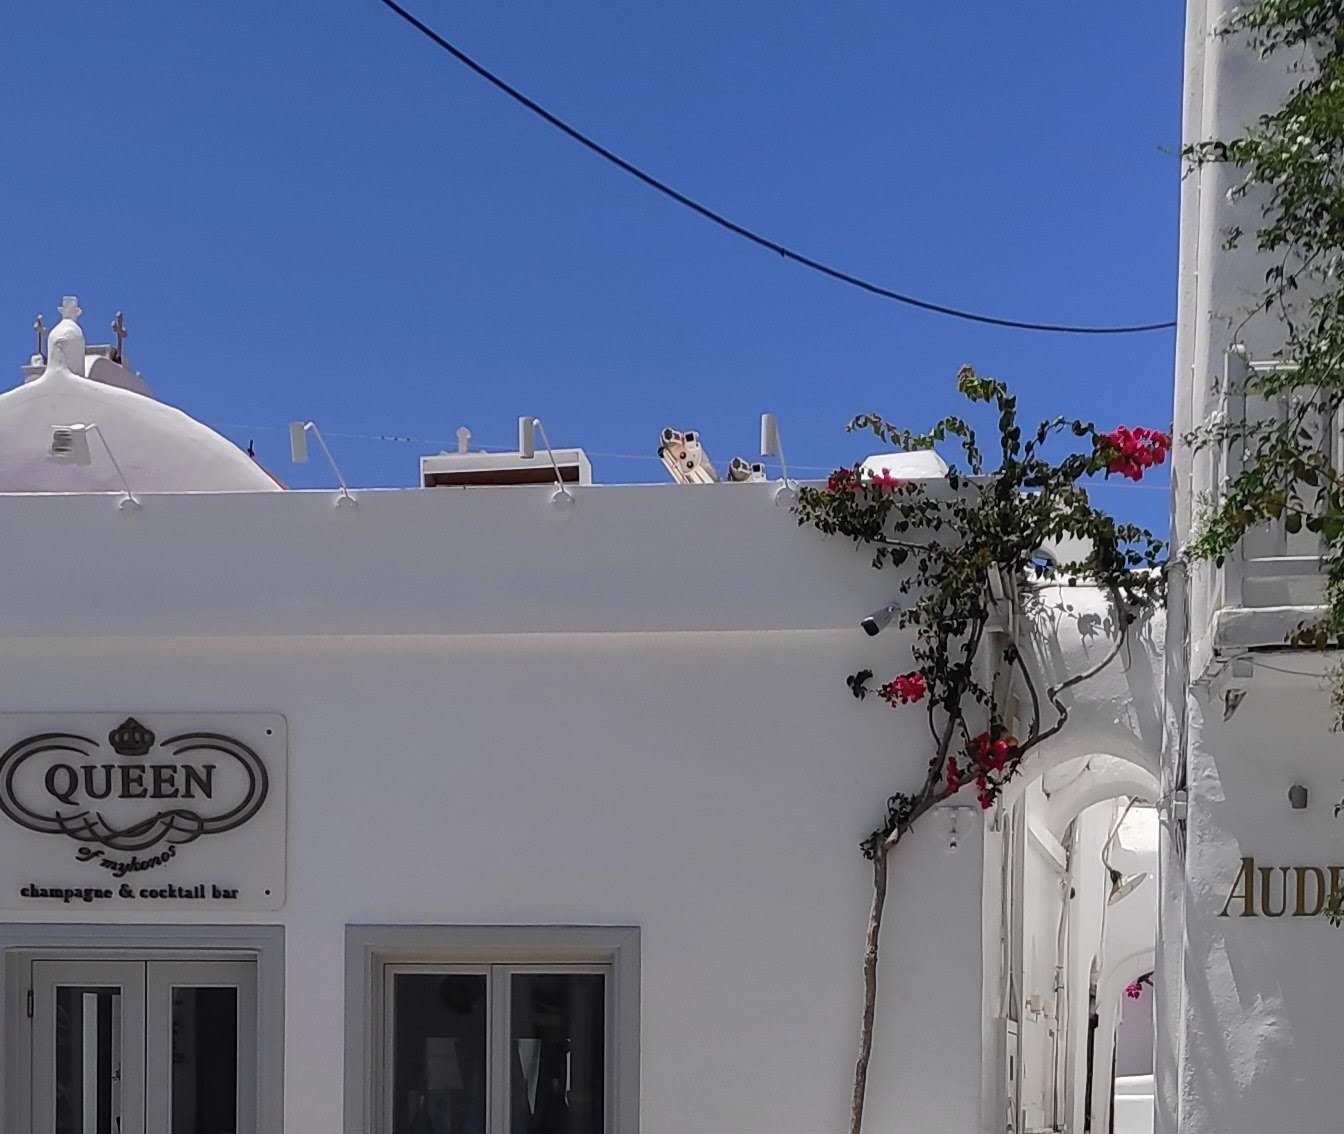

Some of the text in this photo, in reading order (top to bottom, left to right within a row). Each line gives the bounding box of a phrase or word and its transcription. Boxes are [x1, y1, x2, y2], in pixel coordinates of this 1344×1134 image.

[44, 763, 217, 806] QUEEN
[75, 845, 176, 878] of mykonos
[20, 883, 239, 904] champagne & cocktail bar
